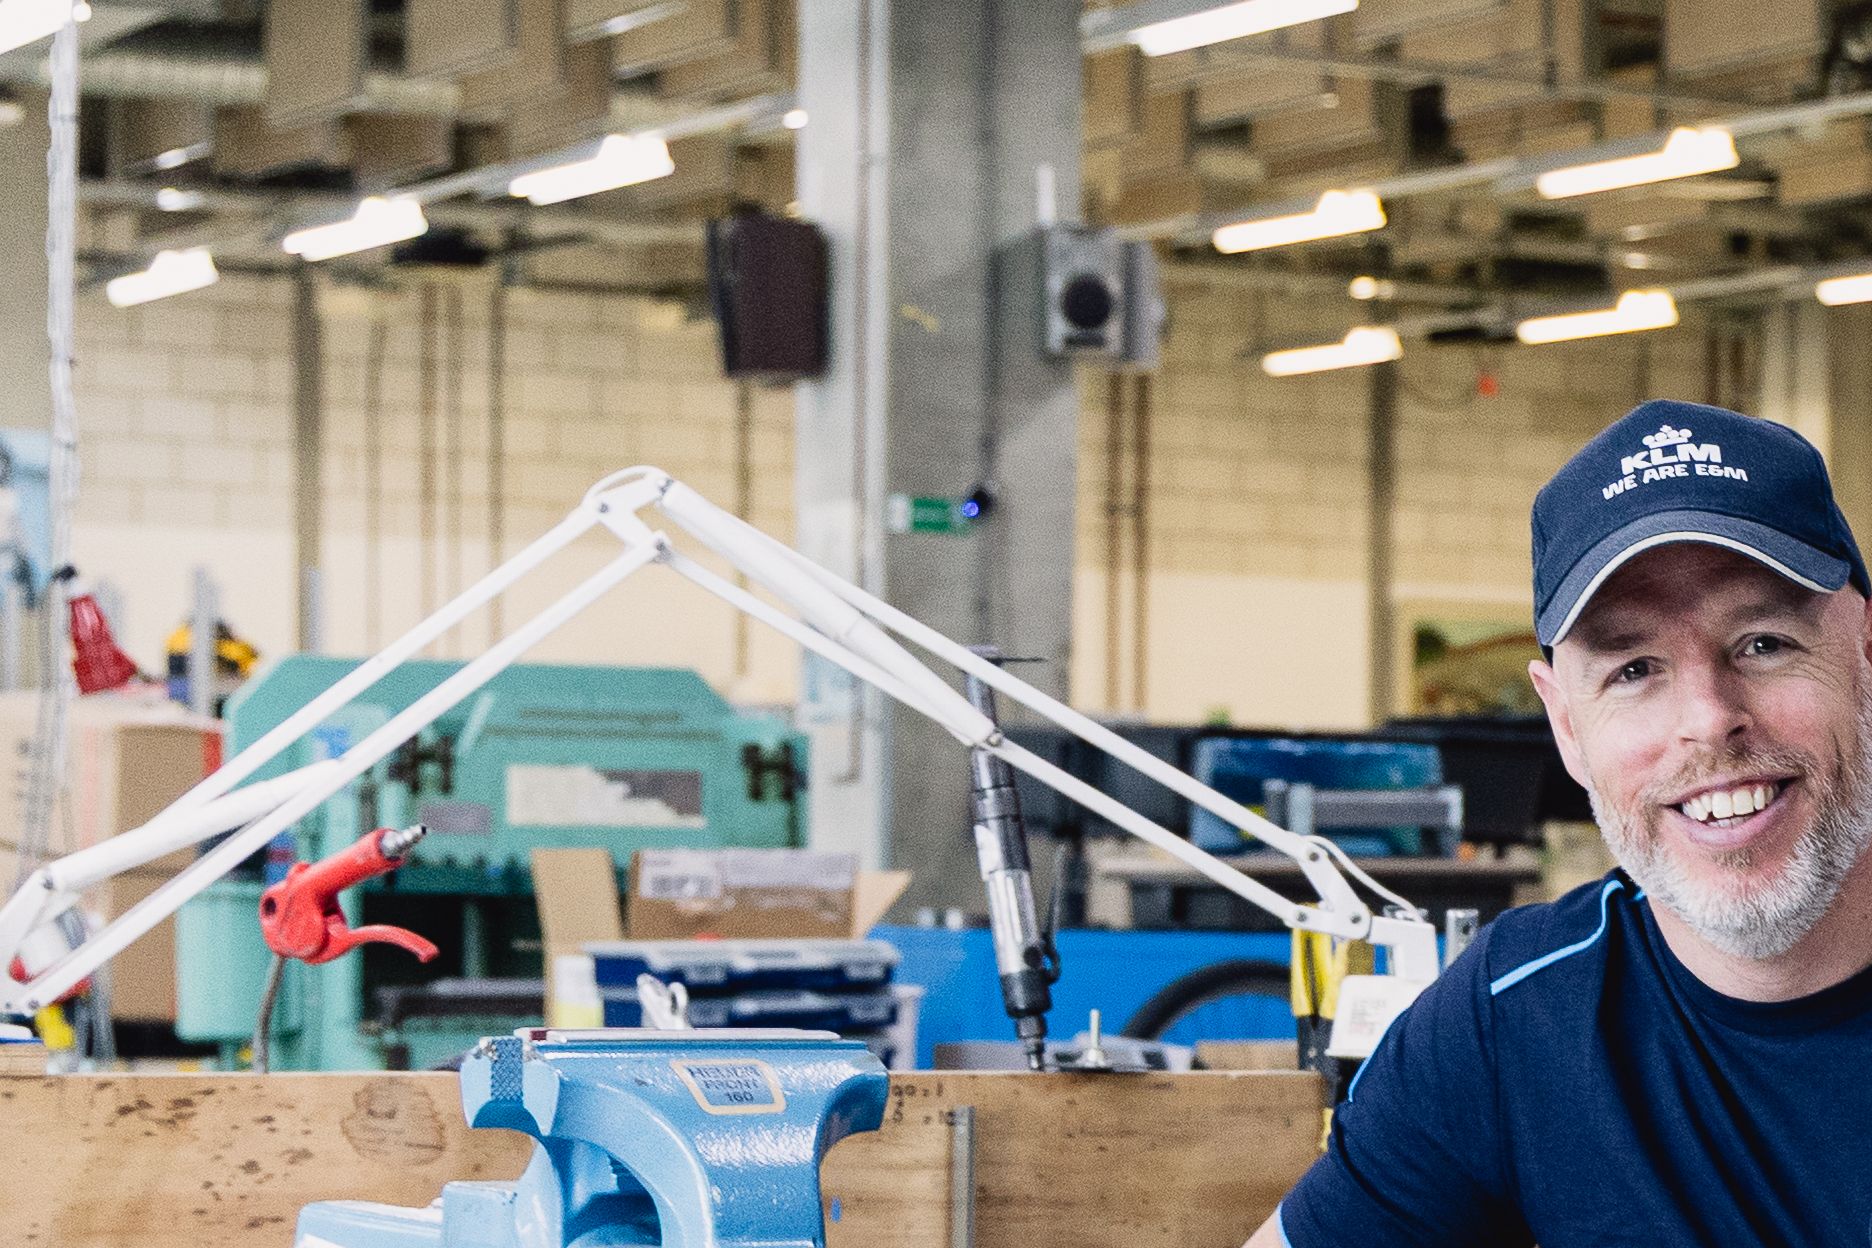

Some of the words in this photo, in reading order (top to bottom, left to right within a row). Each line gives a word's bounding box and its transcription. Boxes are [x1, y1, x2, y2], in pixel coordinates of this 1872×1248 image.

[1620, 443, 1722, 475] KLM
[1602, 474, 1637, 500] WE
[1642, 464, 1689, 484] ARE
[1695, 463, 1748, 482] E&M
[724, 1091, 754, 1103] 160
